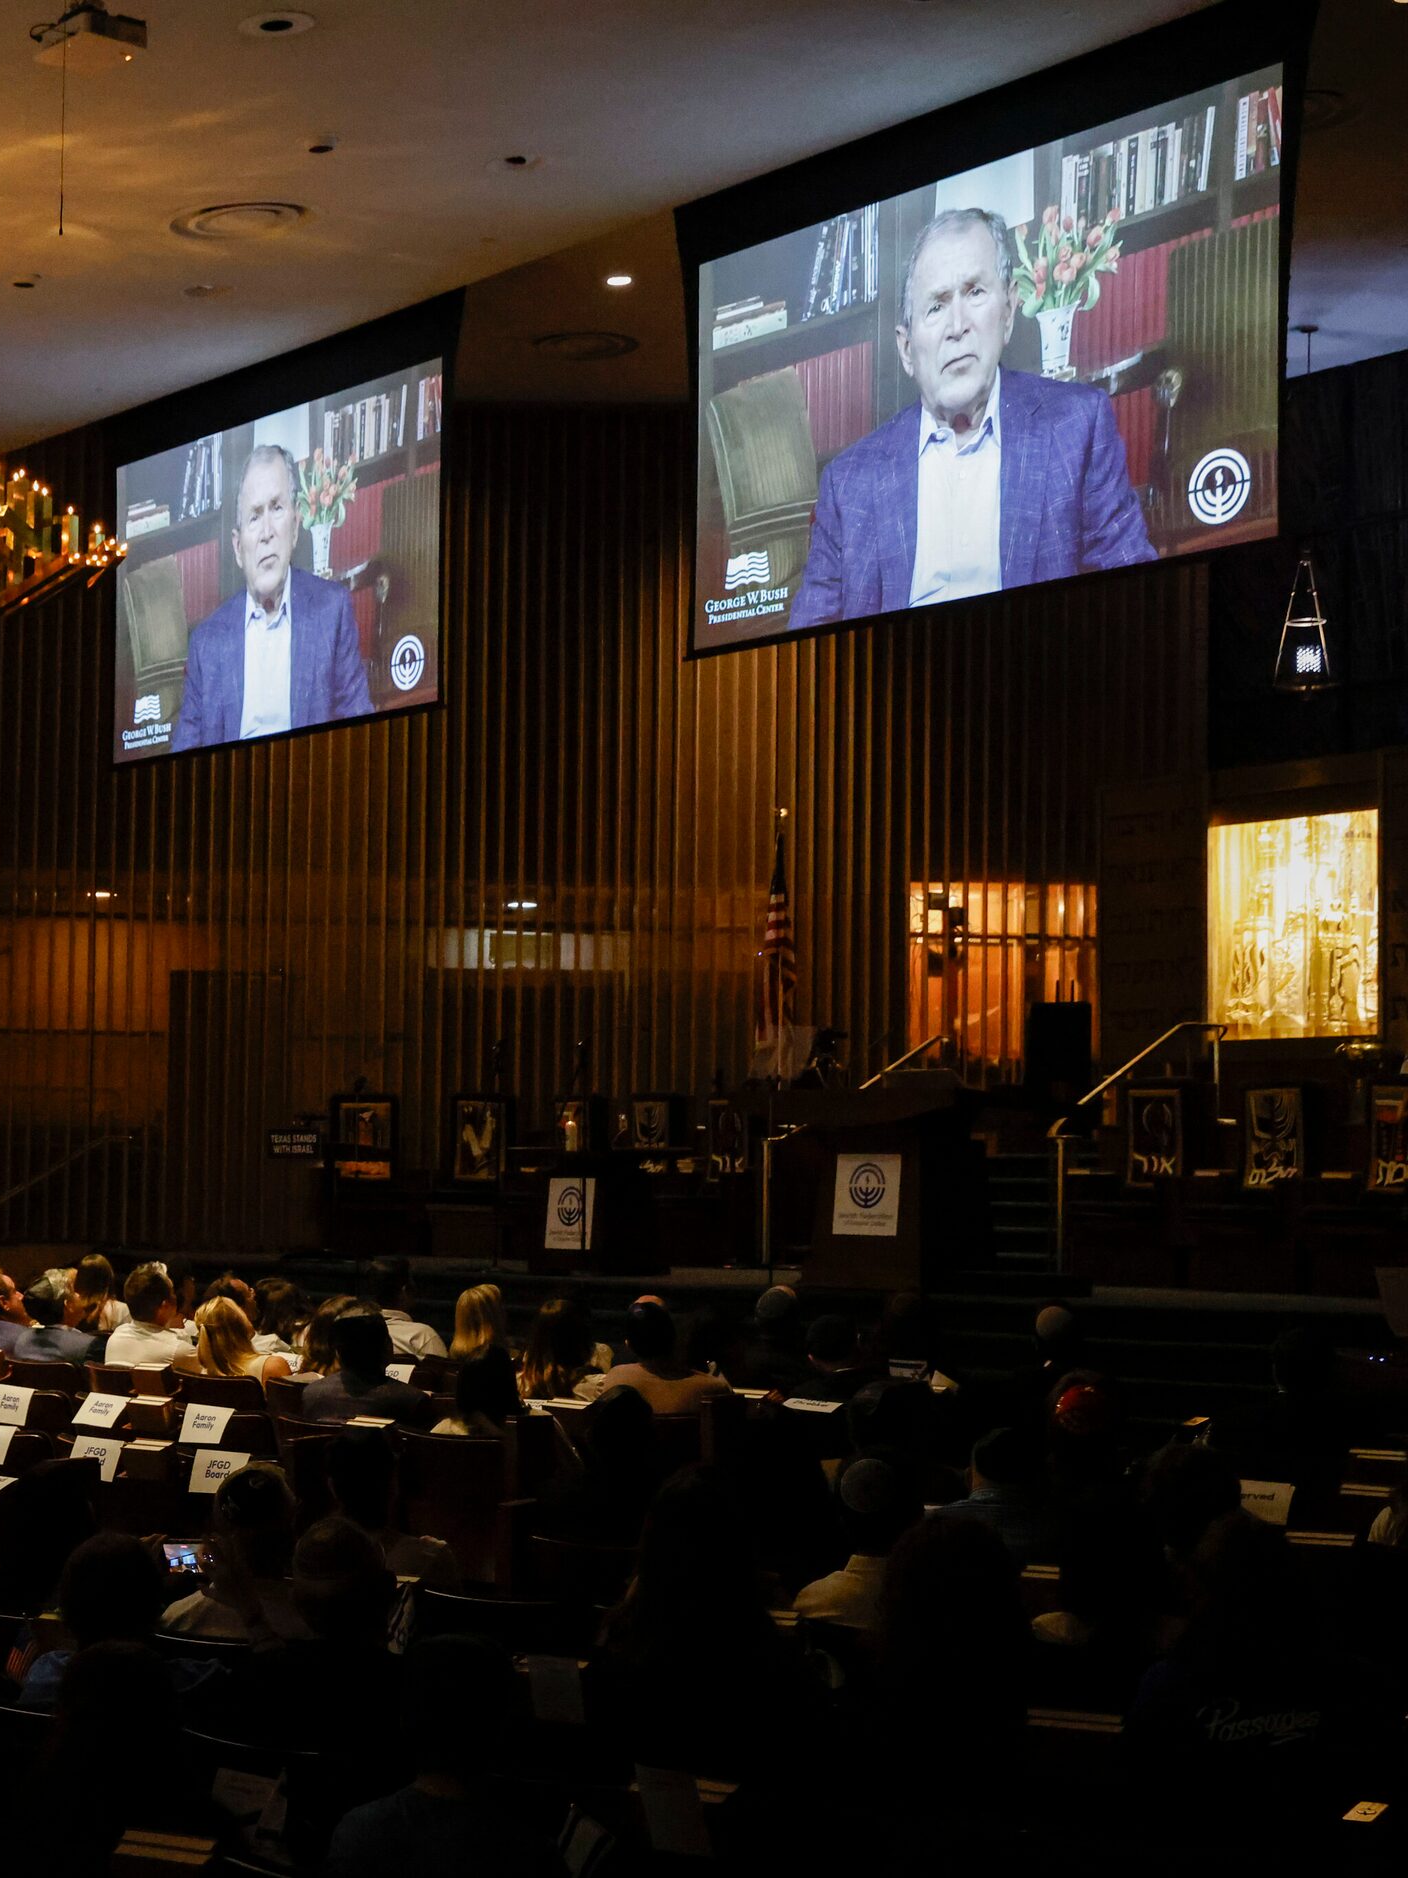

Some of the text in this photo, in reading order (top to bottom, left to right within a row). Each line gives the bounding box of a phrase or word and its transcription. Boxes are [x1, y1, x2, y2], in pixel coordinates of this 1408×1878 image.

[705, 596, 746, 613] GEORGE
[760, 587, 788, 602] BUSH
[708, 602, 785, 625] PRESIDENTIAL CENTER
[122, 728, 147, 741] GEORGE
[154, 723, 171, 735] BUSH
[270, 1134, 317, 1143] TEXAS STANDS
[272, 1144, 314, 1154] WITH ISRAEL
[2, 1394, 20, 1402] Aaron
[0, 1402, 19, 1413] Family
[94, 1401, 113, 1409] Aaron
[89, 1407, 110, 1417] Family
[194, 1413, 216, 1421] Aaron
[192, 1421, 214, 1431] Family
[84, 1446, 107, 1457] JFGD
[207, 1460, 231, 1470] JFGD
[205, 1470, 231, 1479] Board
